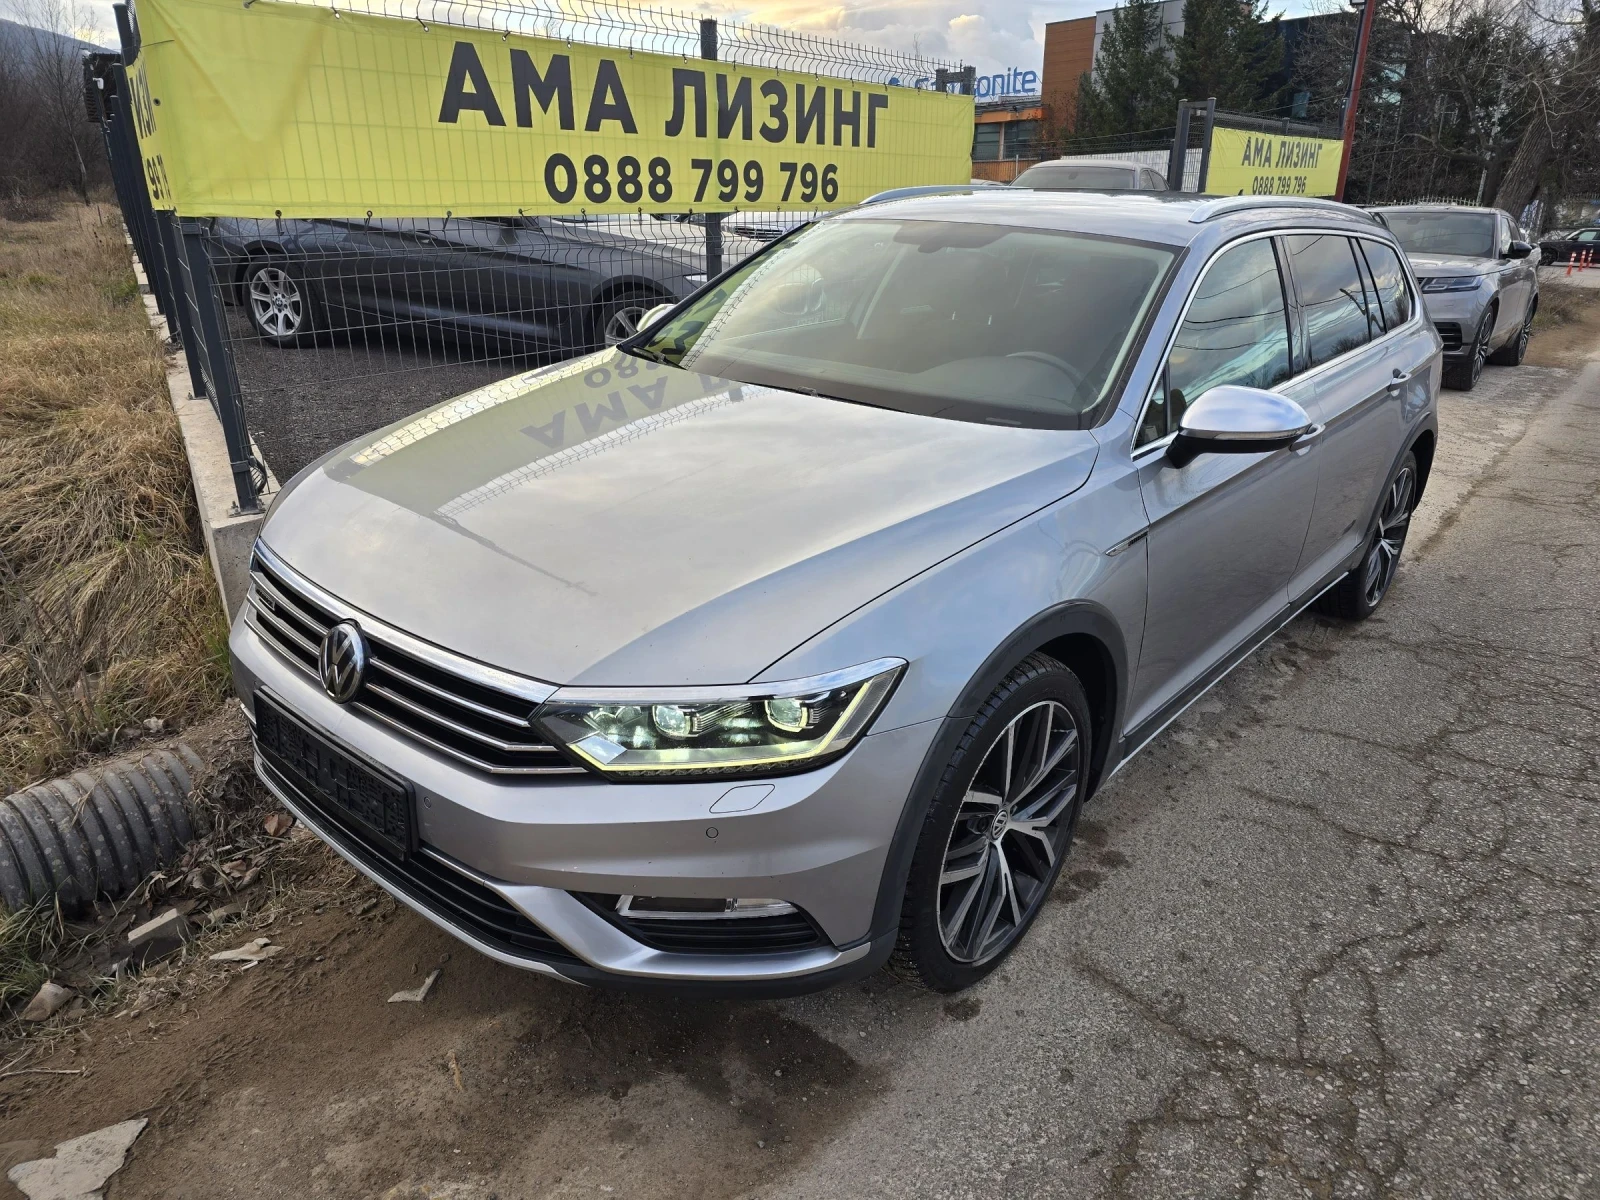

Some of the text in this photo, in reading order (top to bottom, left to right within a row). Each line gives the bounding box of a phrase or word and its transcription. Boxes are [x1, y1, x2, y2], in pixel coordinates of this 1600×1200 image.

[438, 41, 889, 149] АМА ЛИЗИНГ
[1241, 136, 1323, 169] АМА ЛИЗИНГ
[544, 152, 839, 204] 0888 799 796
[1252, 175, 1307, 195] 0888 799 796
